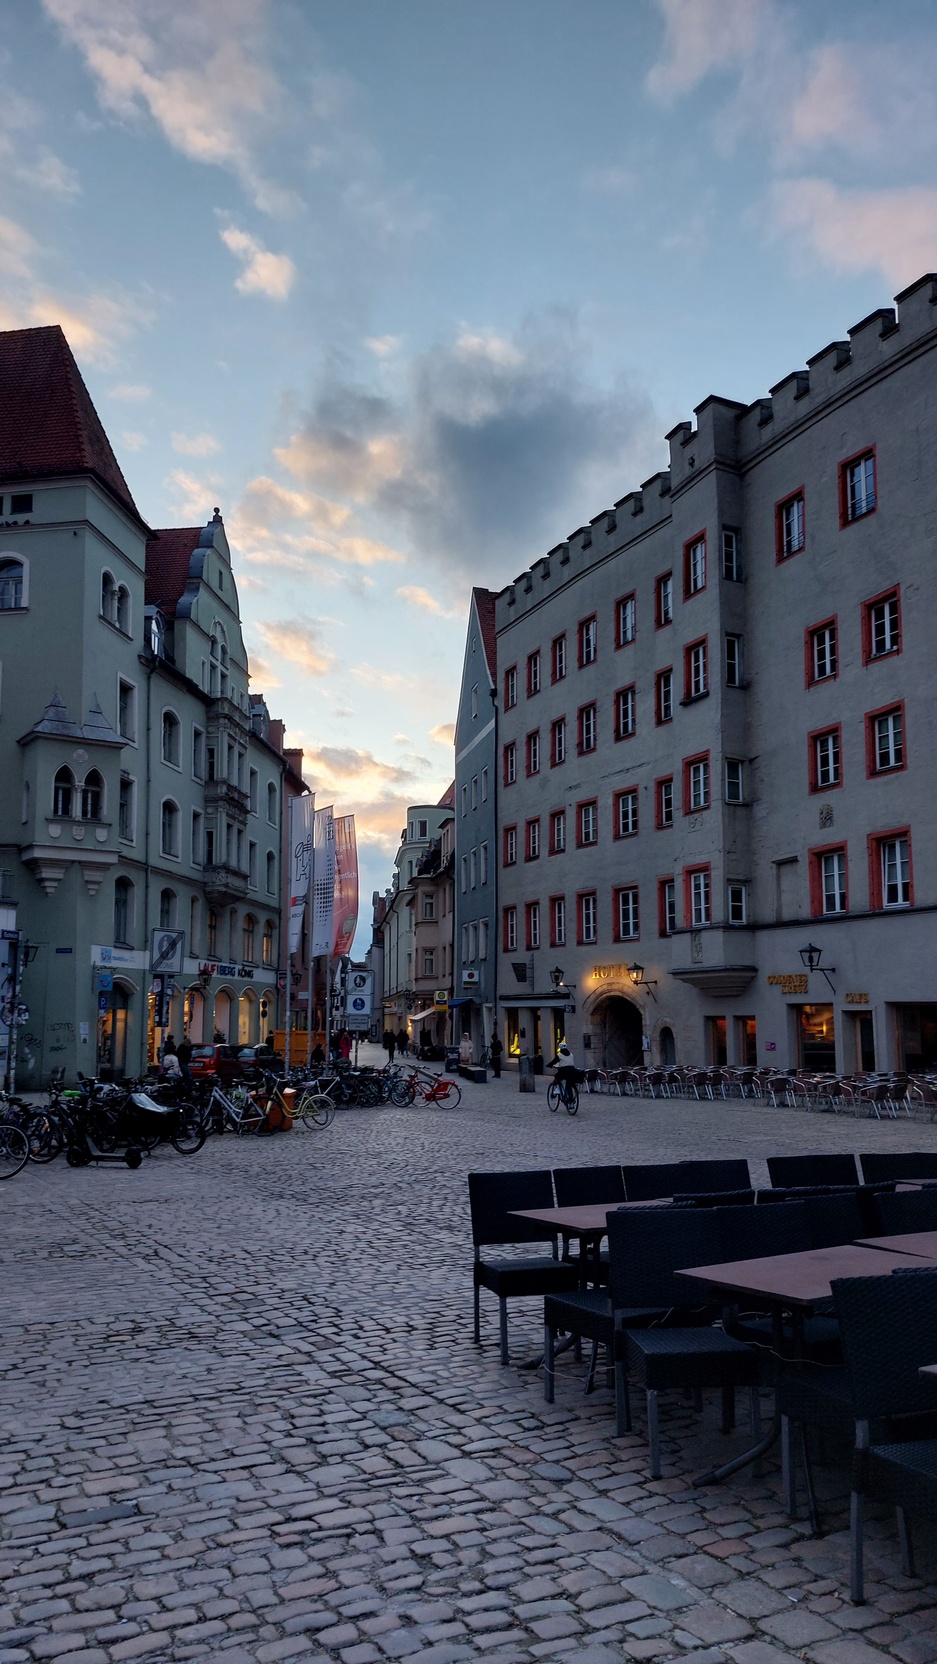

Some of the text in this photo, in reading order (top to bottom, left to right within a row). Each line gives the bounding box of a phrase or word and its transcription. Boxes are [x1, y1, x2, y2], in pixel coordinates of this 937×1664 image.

[219, 965, 235, 977] BERG
[782, 984, 808, 994] KREUZ
[100, 997, 106, 1008] P
